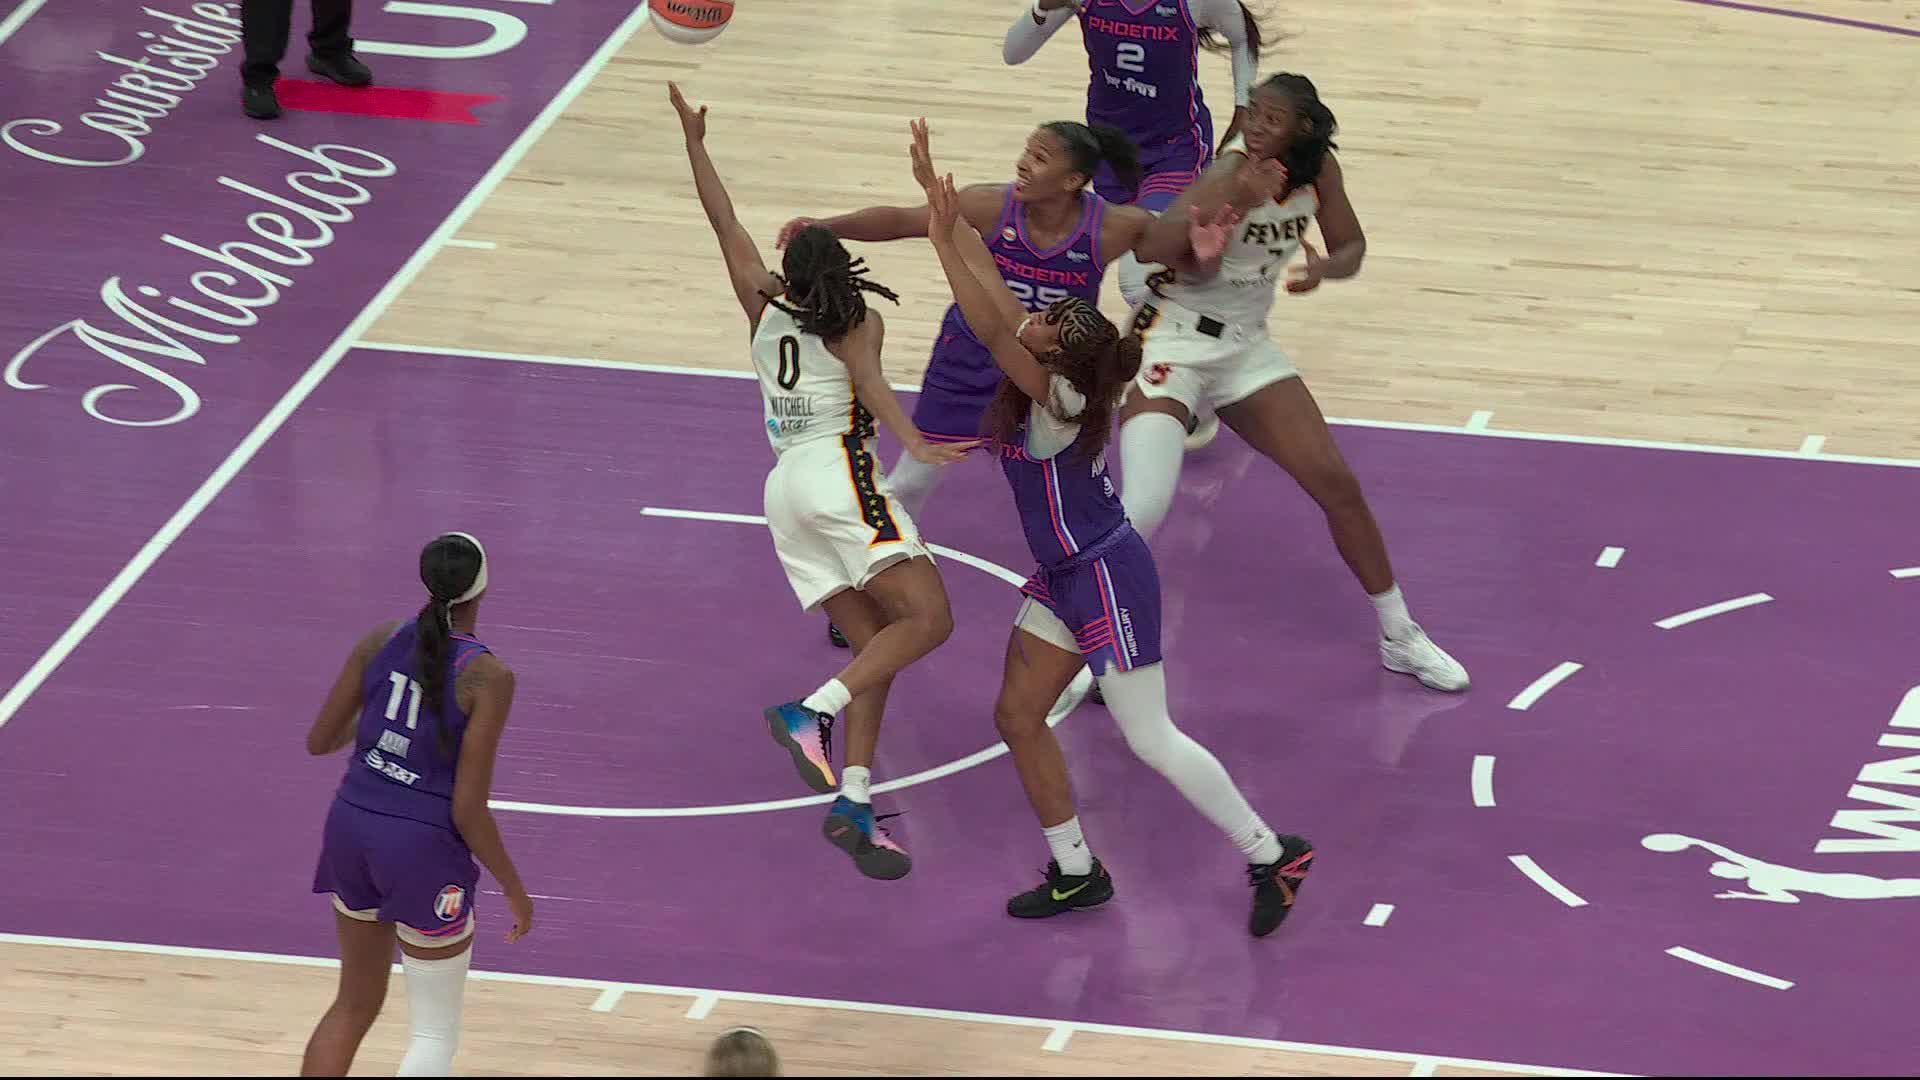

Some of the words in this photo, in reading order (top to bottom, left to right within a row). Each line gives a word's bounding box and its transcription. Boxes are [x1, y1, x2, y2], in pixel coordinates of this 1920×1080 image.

[666, 0, 722, 20] Wilson
[1088, 15, 1180, 41] PHOENIX
[1116, 41, 1145, 73] 2
[1242, 215, 1308, 245] FEVER
[3, 133, 397, 427] Michelob
[994, 252, 1089, 288] PHOENIX
[777, 335, 801, 391] 0
[1119, 607, 1140, 657] MERCURY
[384, 670, 424, 730] 11
